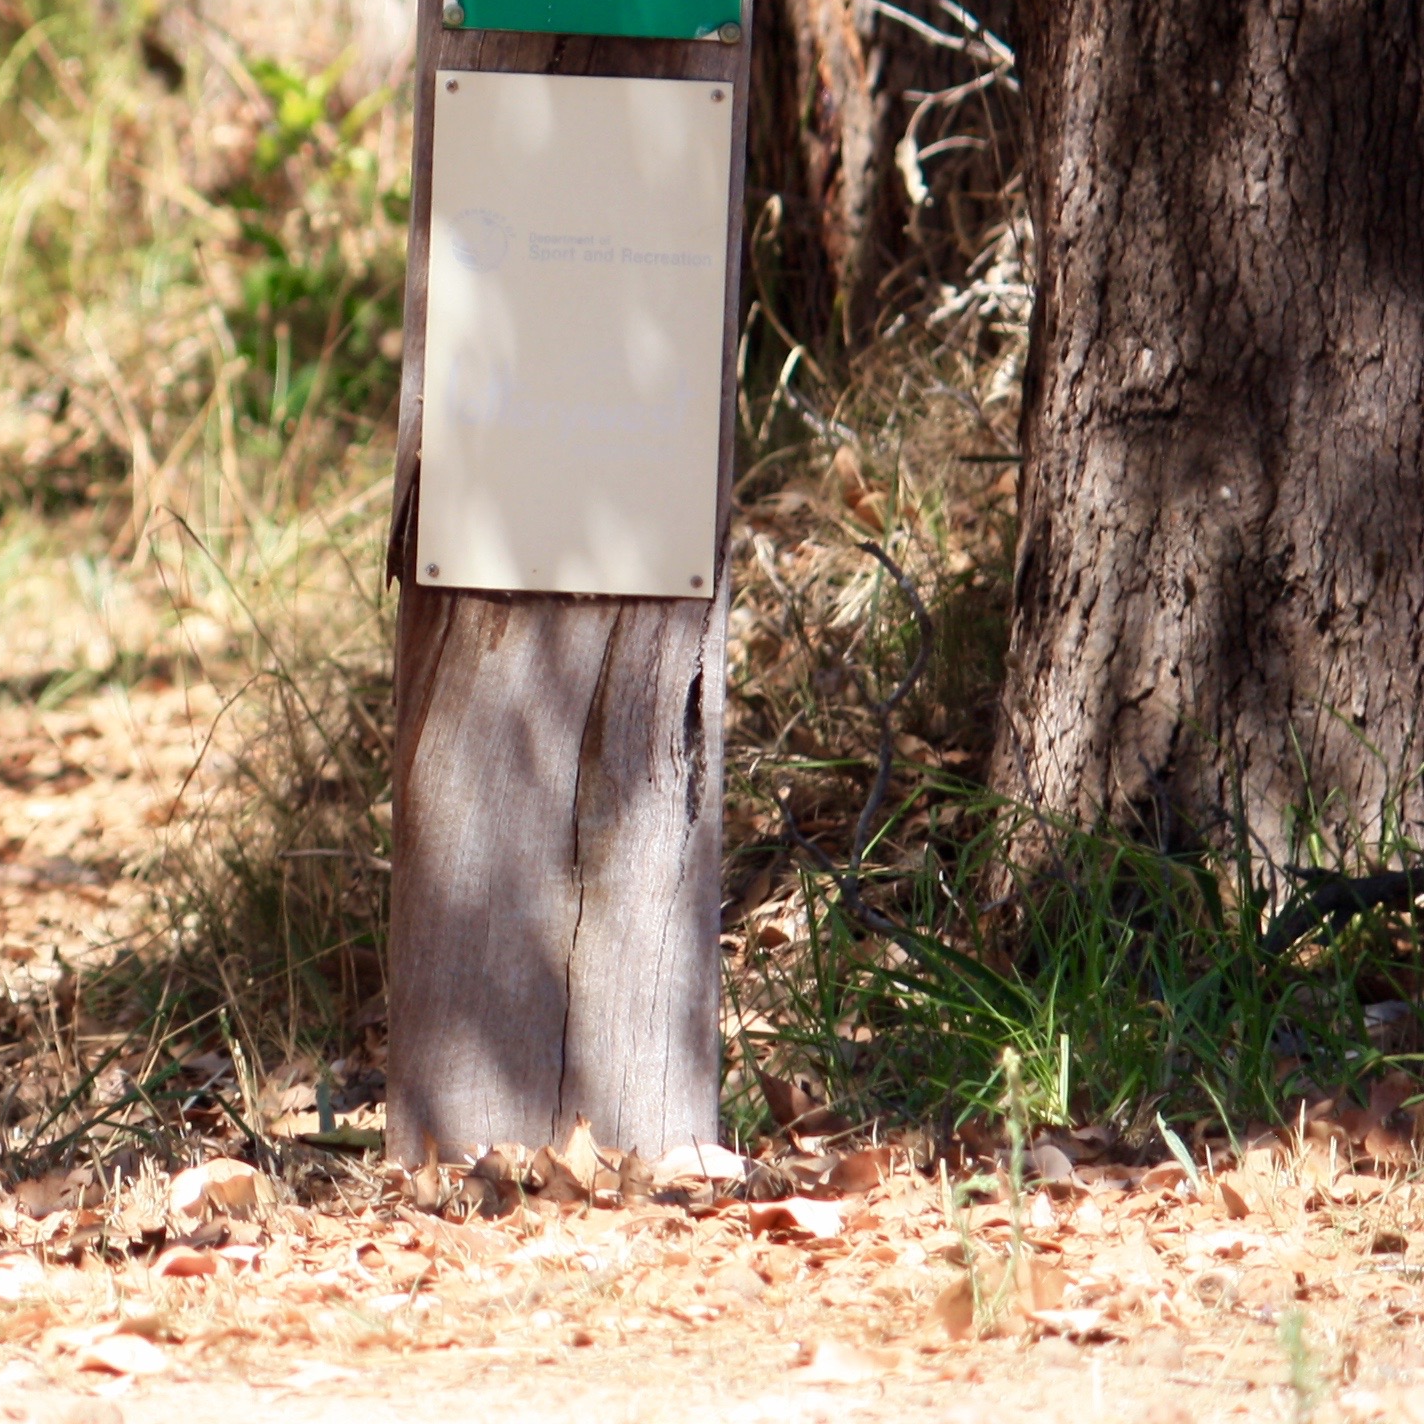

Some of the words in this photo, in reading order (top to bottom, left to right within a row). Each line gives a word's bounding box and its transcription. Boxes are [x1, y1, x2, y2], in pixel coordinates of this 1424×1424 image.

[529, 243, 575, 262] Sport
[584, 248, 613, 263] and
[622, 248, 713, 267] Recreation
